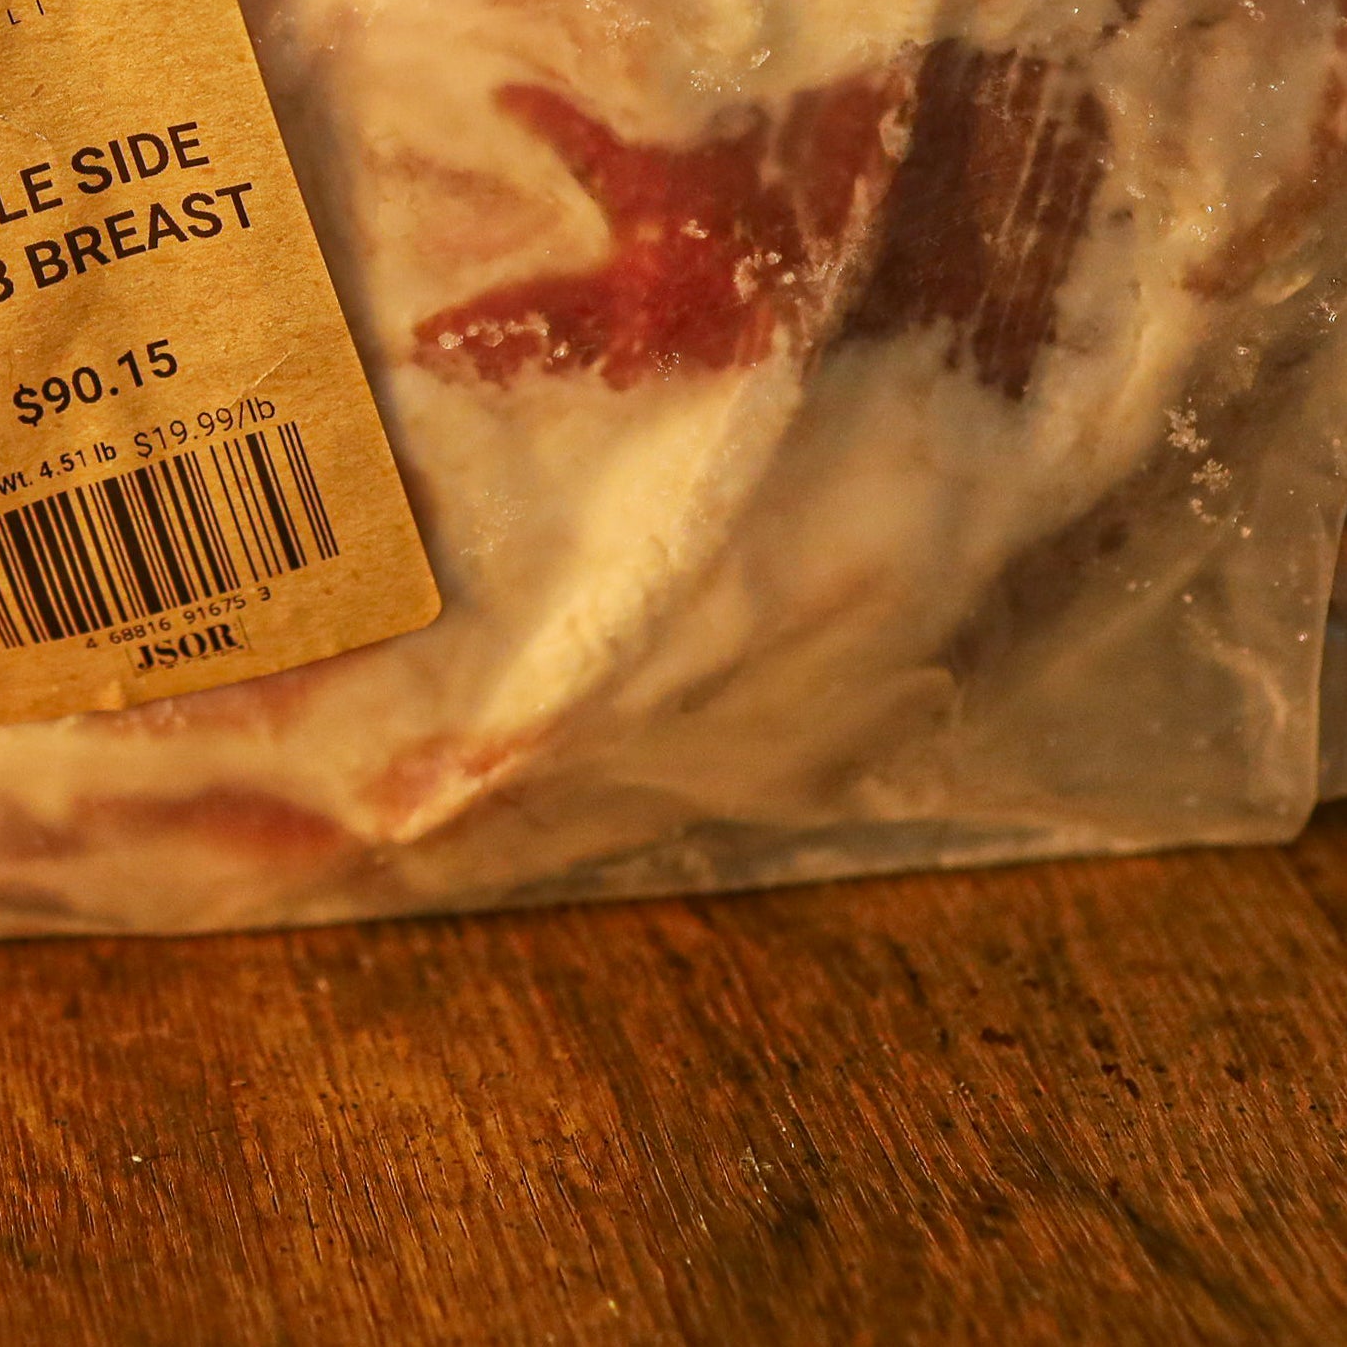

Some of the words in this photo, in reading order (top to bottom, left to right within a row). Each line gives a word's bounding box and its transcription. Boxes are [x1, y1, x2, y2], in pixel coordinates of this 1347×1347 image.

[71, 121, 210, 194] SIDE
[24, 182, 253, 289] BREAST
[13, 339, 178, 427] $90.15
[40, 449, 88, 480] 4.51
[93, 442, 118, 464] lb
[134, 397, 276, 459] $19.99/lb
[85, 637, 98, 649] 4
[109, 617, 172, 645] 68816
[183, 594, 247, 625] 91675
[257, 586, 272, 602] 3
